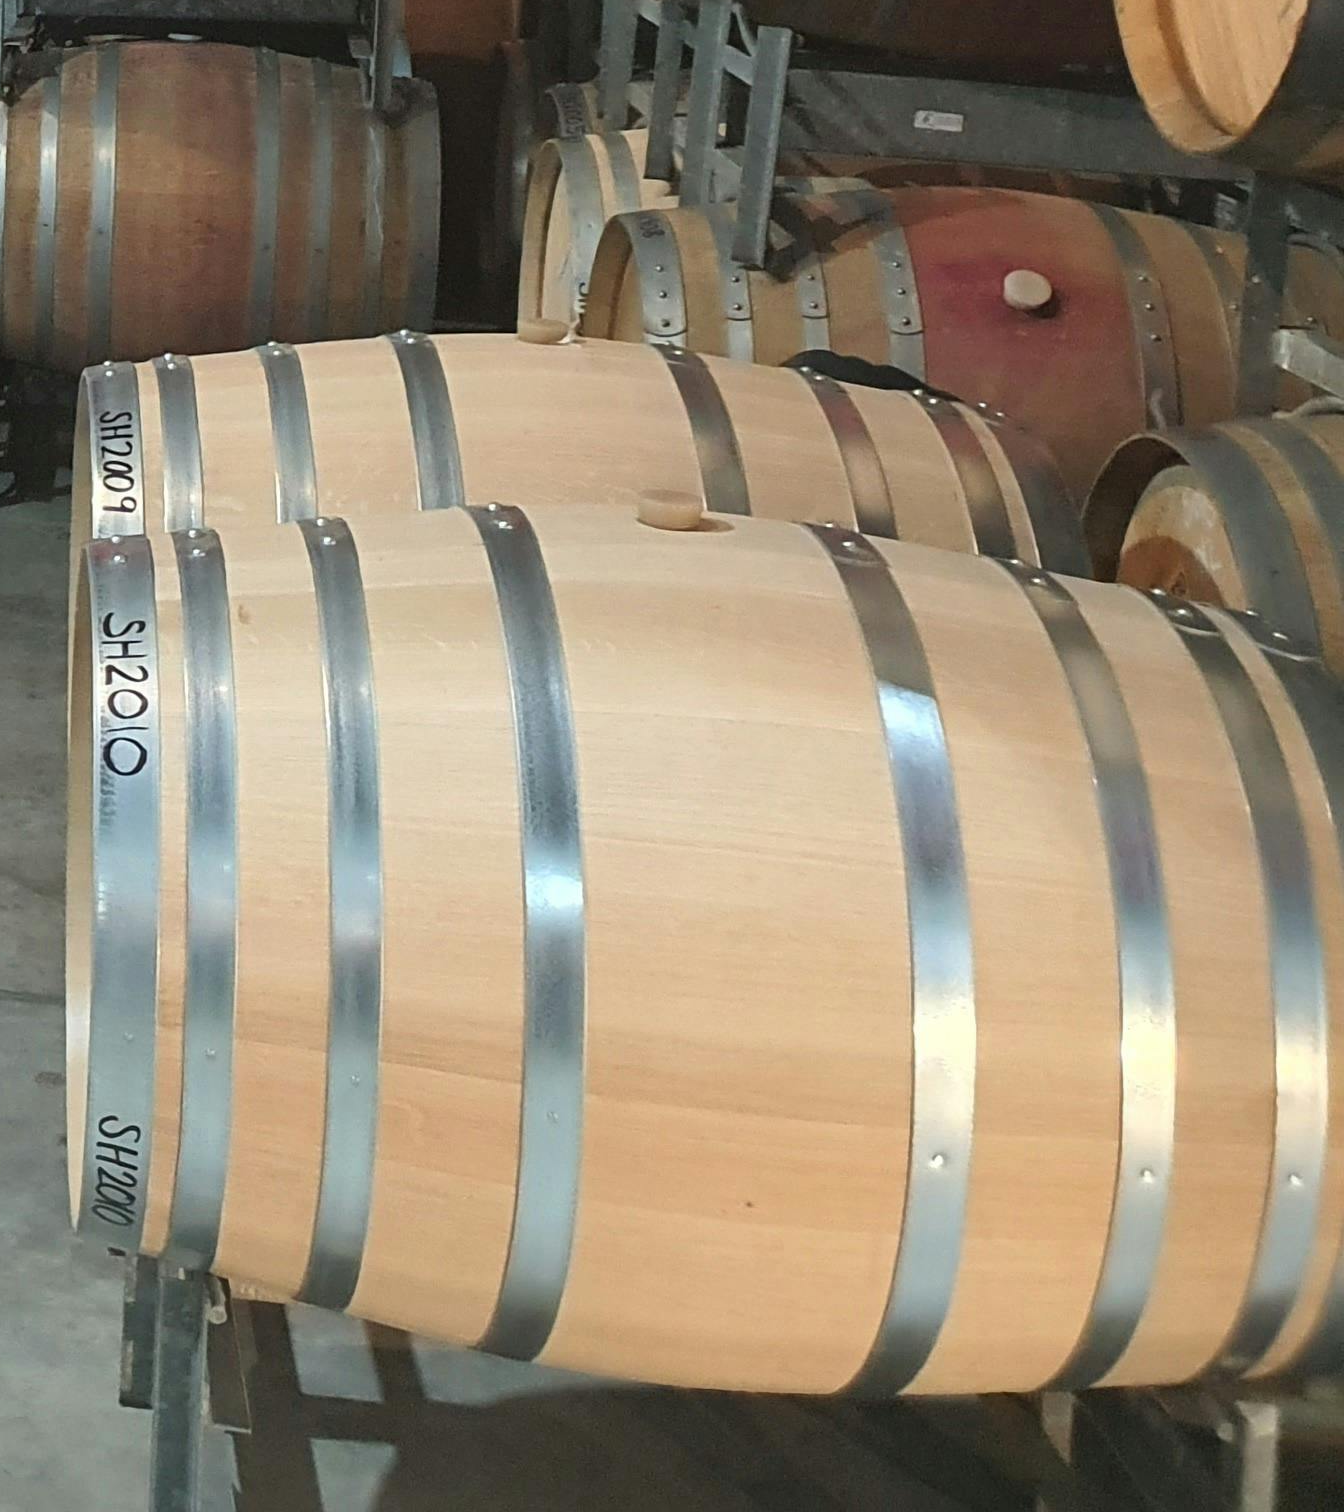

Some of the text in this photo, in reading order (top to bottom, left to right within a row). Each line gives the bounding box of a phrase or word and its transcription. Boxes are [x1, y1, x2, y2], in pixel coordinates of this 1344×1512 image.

[99, 410, 137, 513] SH2009
[101, 611, 149, 777] SH2010
[91, 1114, 142, 1227] SH2010
